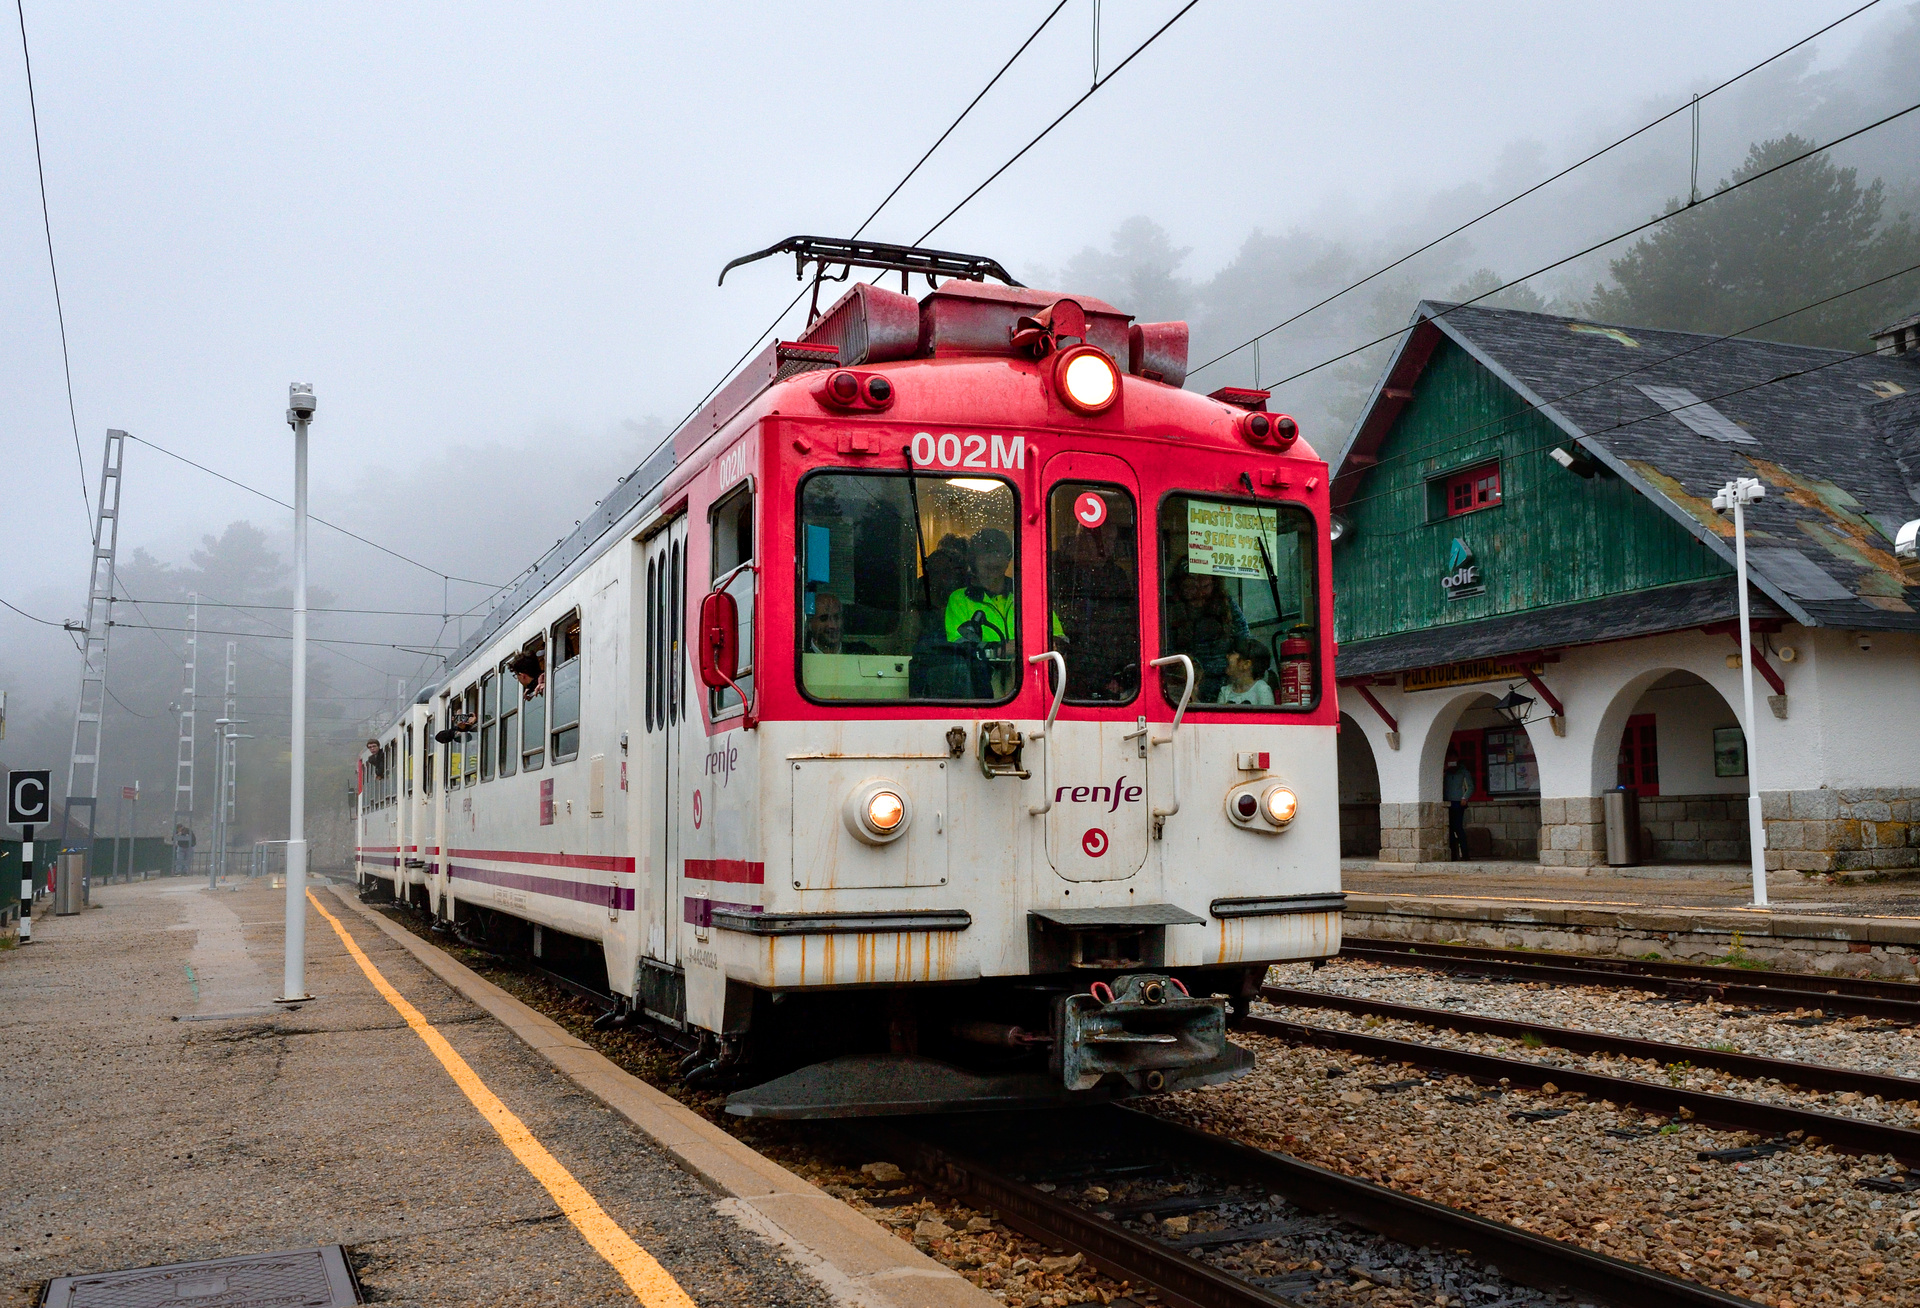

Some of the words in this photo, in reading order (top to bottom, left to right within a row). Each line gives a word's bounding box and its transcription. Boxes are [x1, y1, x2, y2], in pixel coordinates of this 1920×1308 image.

[720, 440, 746, 491] 002M
[911, 432, 1025, 470] 002M
[1190, 508, 1233, 527] HASTA
[1441, 565, 1479, 588] adif
[705, 733, 738, 788] renfe
[15, 778, 44, 816] C
[1055, 775, 1143, 813] renfe
